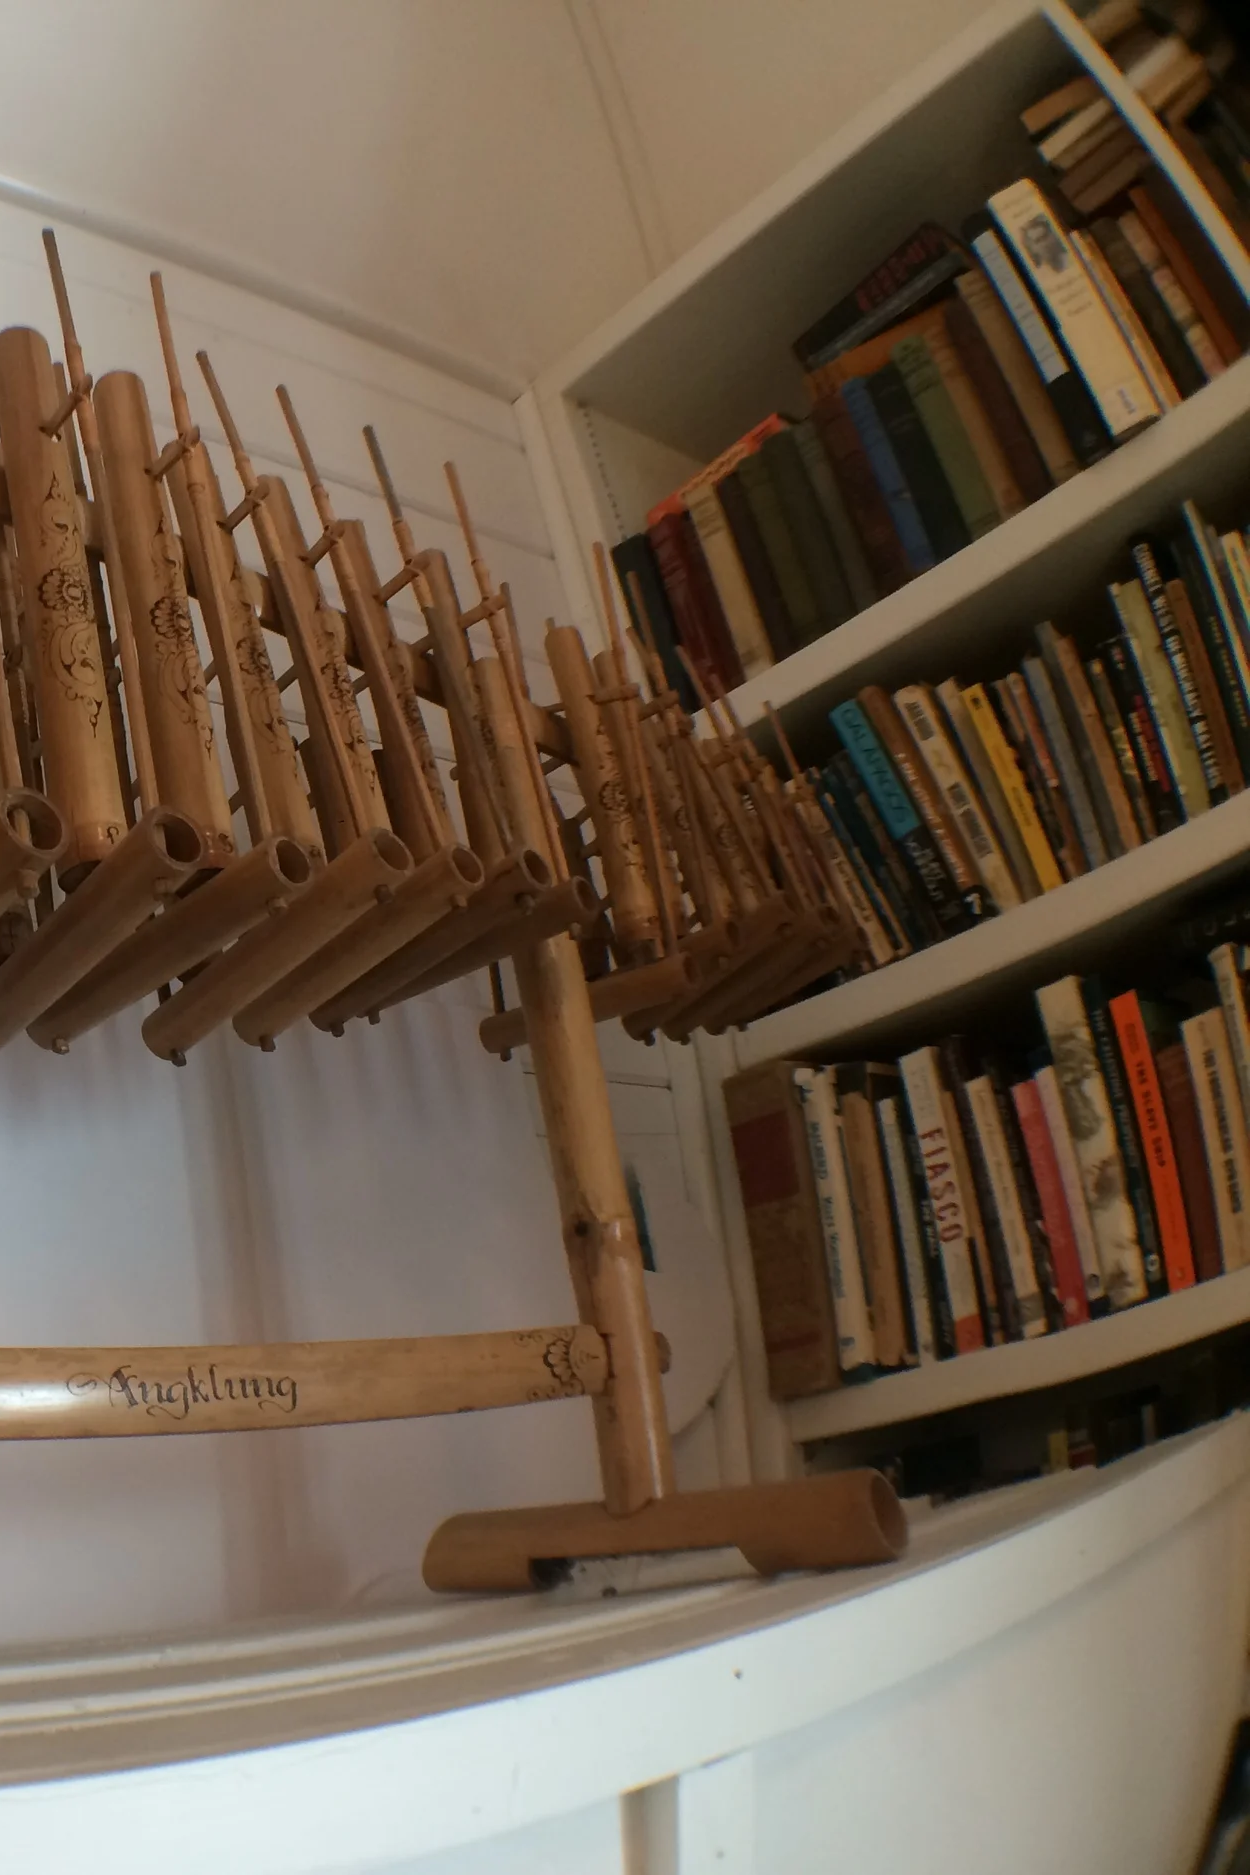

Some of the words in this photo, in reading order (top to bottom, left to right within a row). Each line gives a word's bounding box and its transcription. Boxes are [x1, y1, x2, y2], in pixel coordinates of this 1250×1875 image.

[1151, 595, 1174, 634] WEST
[1134, 1062, 1149, 1085] THE
[920, 1127, 963, 1243] FIASCO
[66, 1363, 297, 1420] Angklung
